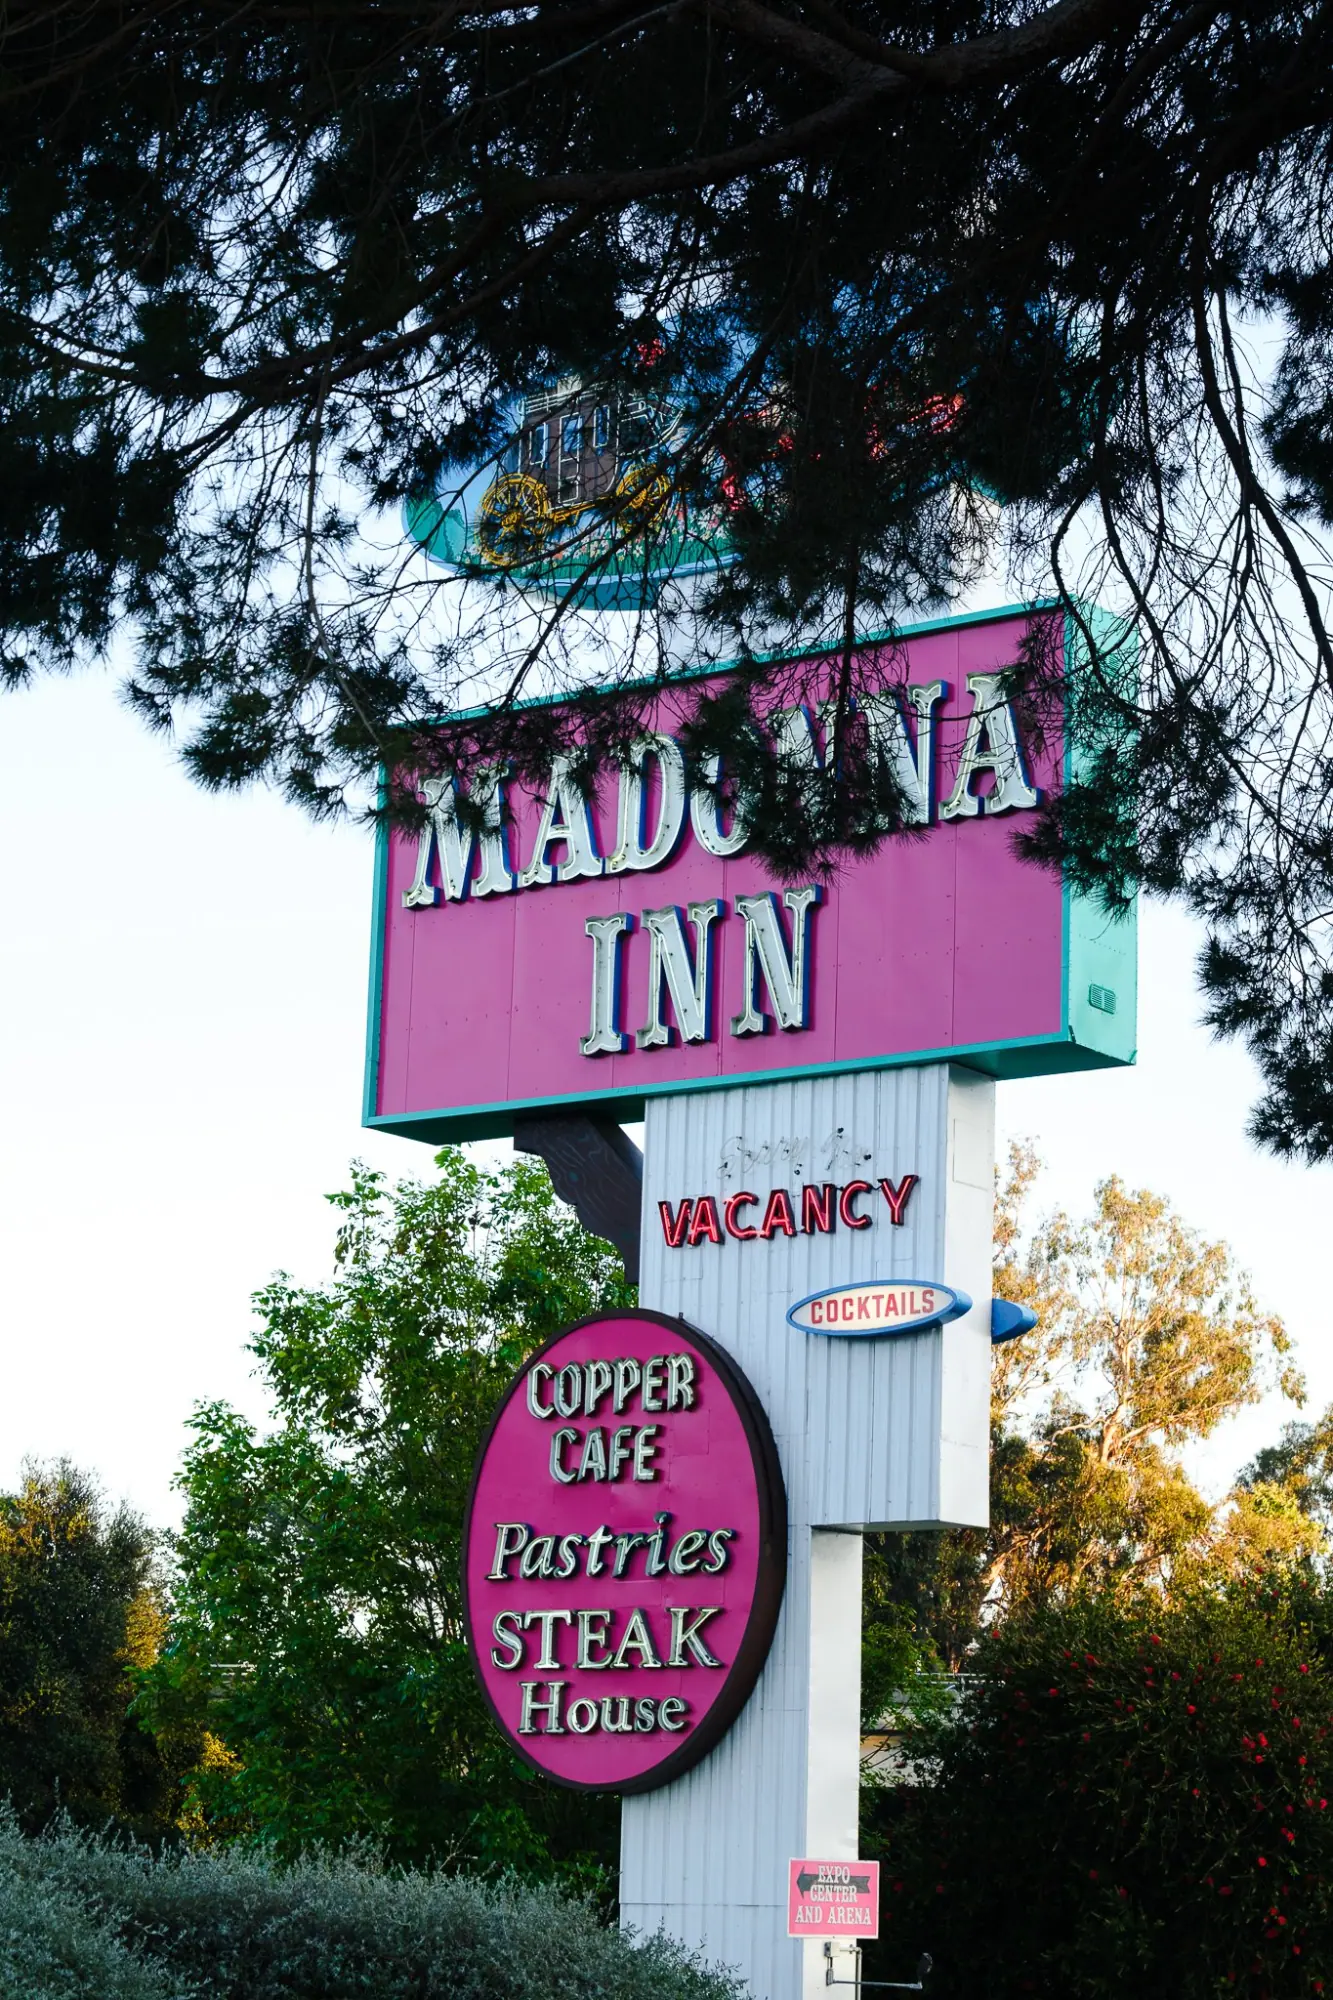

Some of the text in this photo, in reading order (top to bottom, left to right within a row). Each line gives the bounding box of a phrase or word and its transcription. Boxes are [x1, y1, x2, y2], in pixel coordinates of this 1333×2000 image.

[579, 884, 823, 1057] INN
[658, 1174, 919, 1248] VACANCY
[810, 1289, 935, 1325] COCKTAILS
[526, 1352, 695, 1420] COPPER
[549, 1423, 660, 1484] CAFE
[485, 1511, 738, 1580] Pastries
[491, 1607, 725, 1671] STEAK
[516, 1680, 690, 1734] House
[810, 1884, 858, 1903] CENTER
[817, 1865, 851, 1884] EXPO
[795, 1905, 872, 1925] AND ARENA
